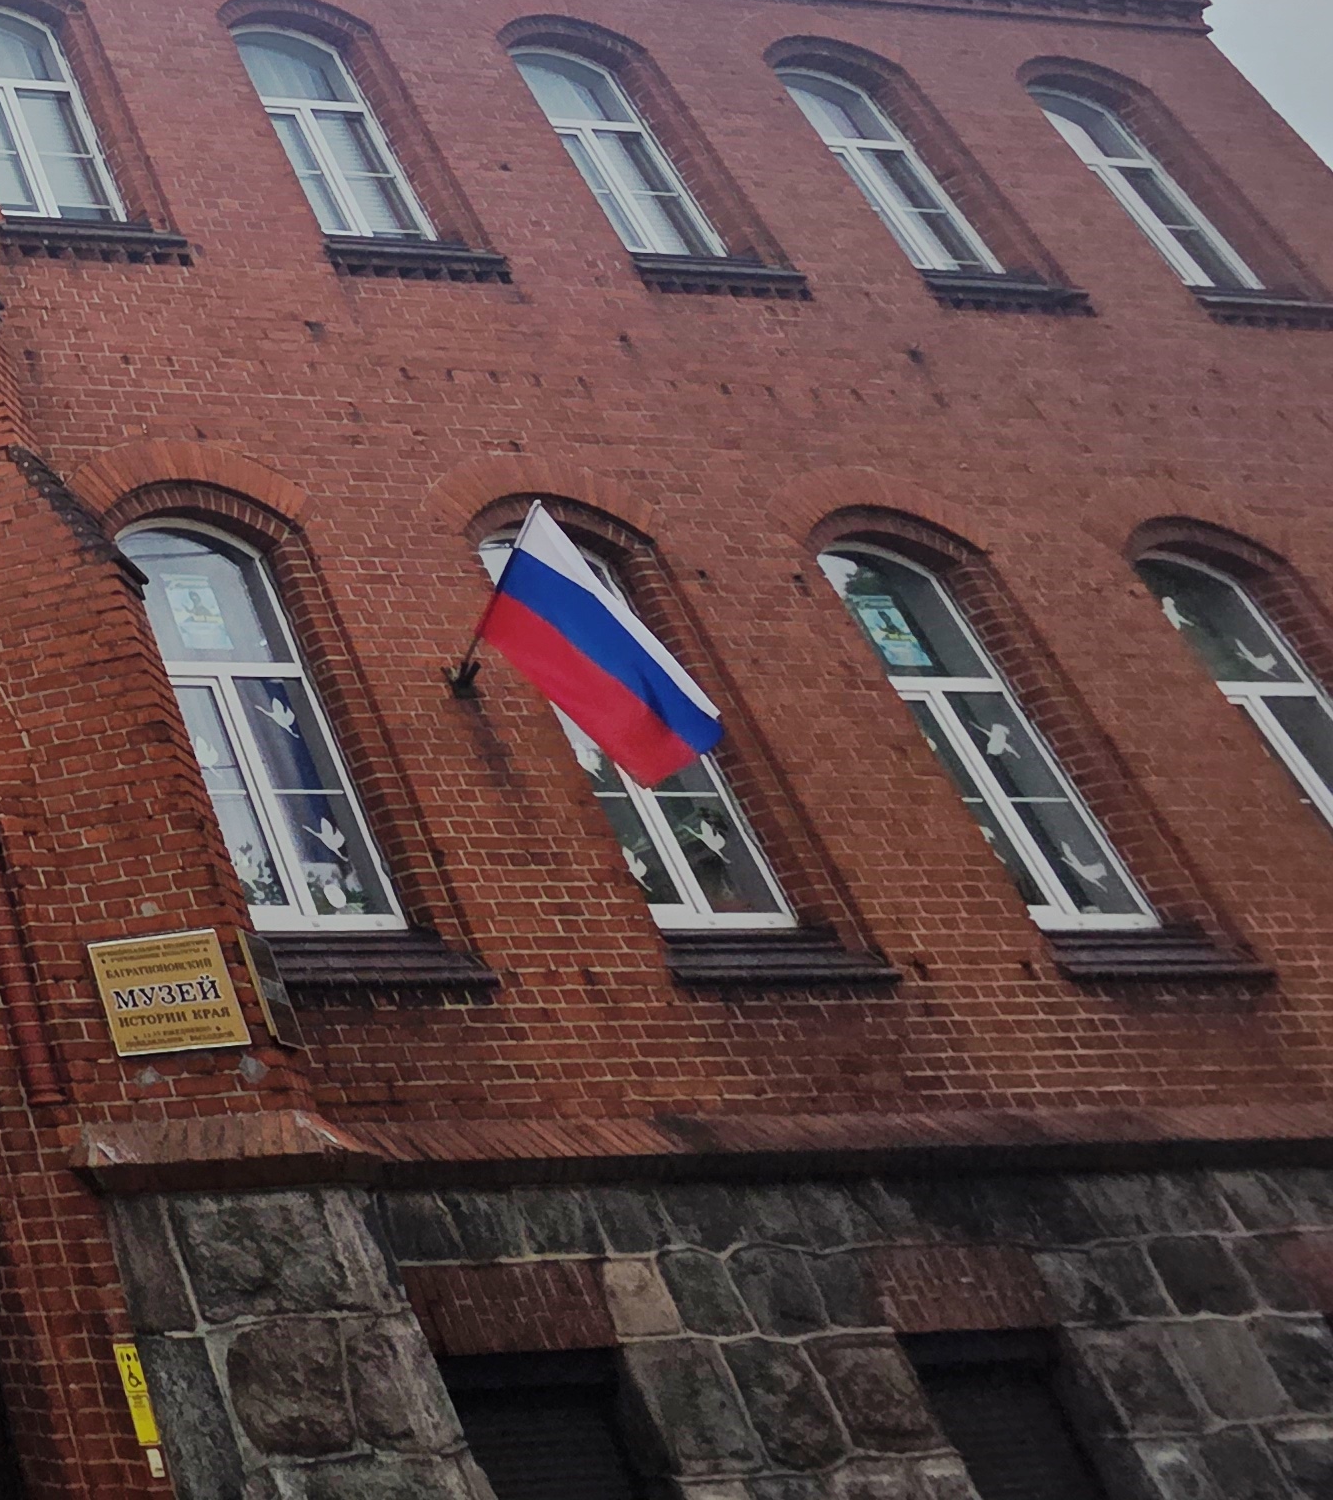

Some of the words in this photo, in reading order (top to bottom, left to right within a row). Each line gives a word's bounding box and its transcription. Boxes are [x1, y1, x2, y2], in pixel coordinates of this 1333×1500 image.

[113, 975, 222, 1009] МУЗЕЙ
[118, 1011, 187, 1028] ИСТОРИИ
[192, 1006, 231, 1020] КРАЯ
